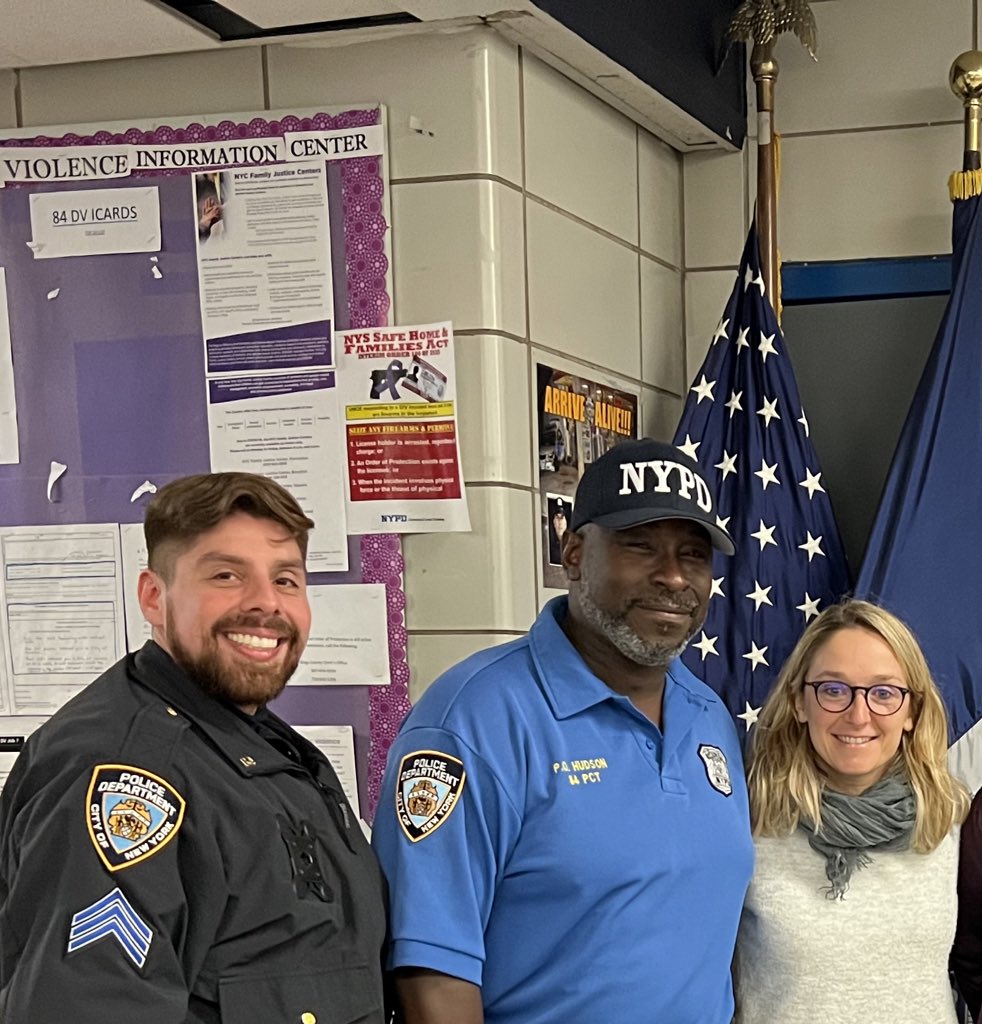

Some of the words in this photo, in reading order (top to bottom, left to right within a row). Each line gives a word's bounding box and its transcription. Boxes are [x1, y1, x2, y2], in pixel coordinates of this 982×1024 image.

[4, 154, 129, 179] VIOLENCE
[136, 144, 278, 168] INFORMATION
[290, 133, 368, 158] CENTER
[234, 172, 249, 180] NYC
[249, 171, 272, 179] Family
[273, 169, 296, 177] Justice
[296, 167, 322, 176] Centers
[52, 210, 68, 224] 84
[70, 208, 88, 222] DV
[91, 205, 138, 221] ICARDS
[344, 333, 371, 345] NYS
[544, 385, 586, 423] ARRIVE
[594, 400, 632, 437] ALIVE!!!
[618, 460, 713, 513] NYPD
[381, 514, 408, 523] NYPD
[413, 758, 448, 772] POLICE
[571, 758, 608, 772] HUDSON
[119, 772, 166, 798] POLICE
[400, 768, 460, 787] DEPARTMENT
[581, 771, 601, 785] PCT
[97, 781, 177, 817] DEPARTMENT
[90, 803, 103, 831] CITY
[402, 814, 412, 828] OF
[420, 815, 440, 833] NEW
[437, 792, 457, 817] YORK
[96, 832, 110, 849] OF
[123, 842, 150, 861] NEW
[148, 821, 175, 846] YORK
